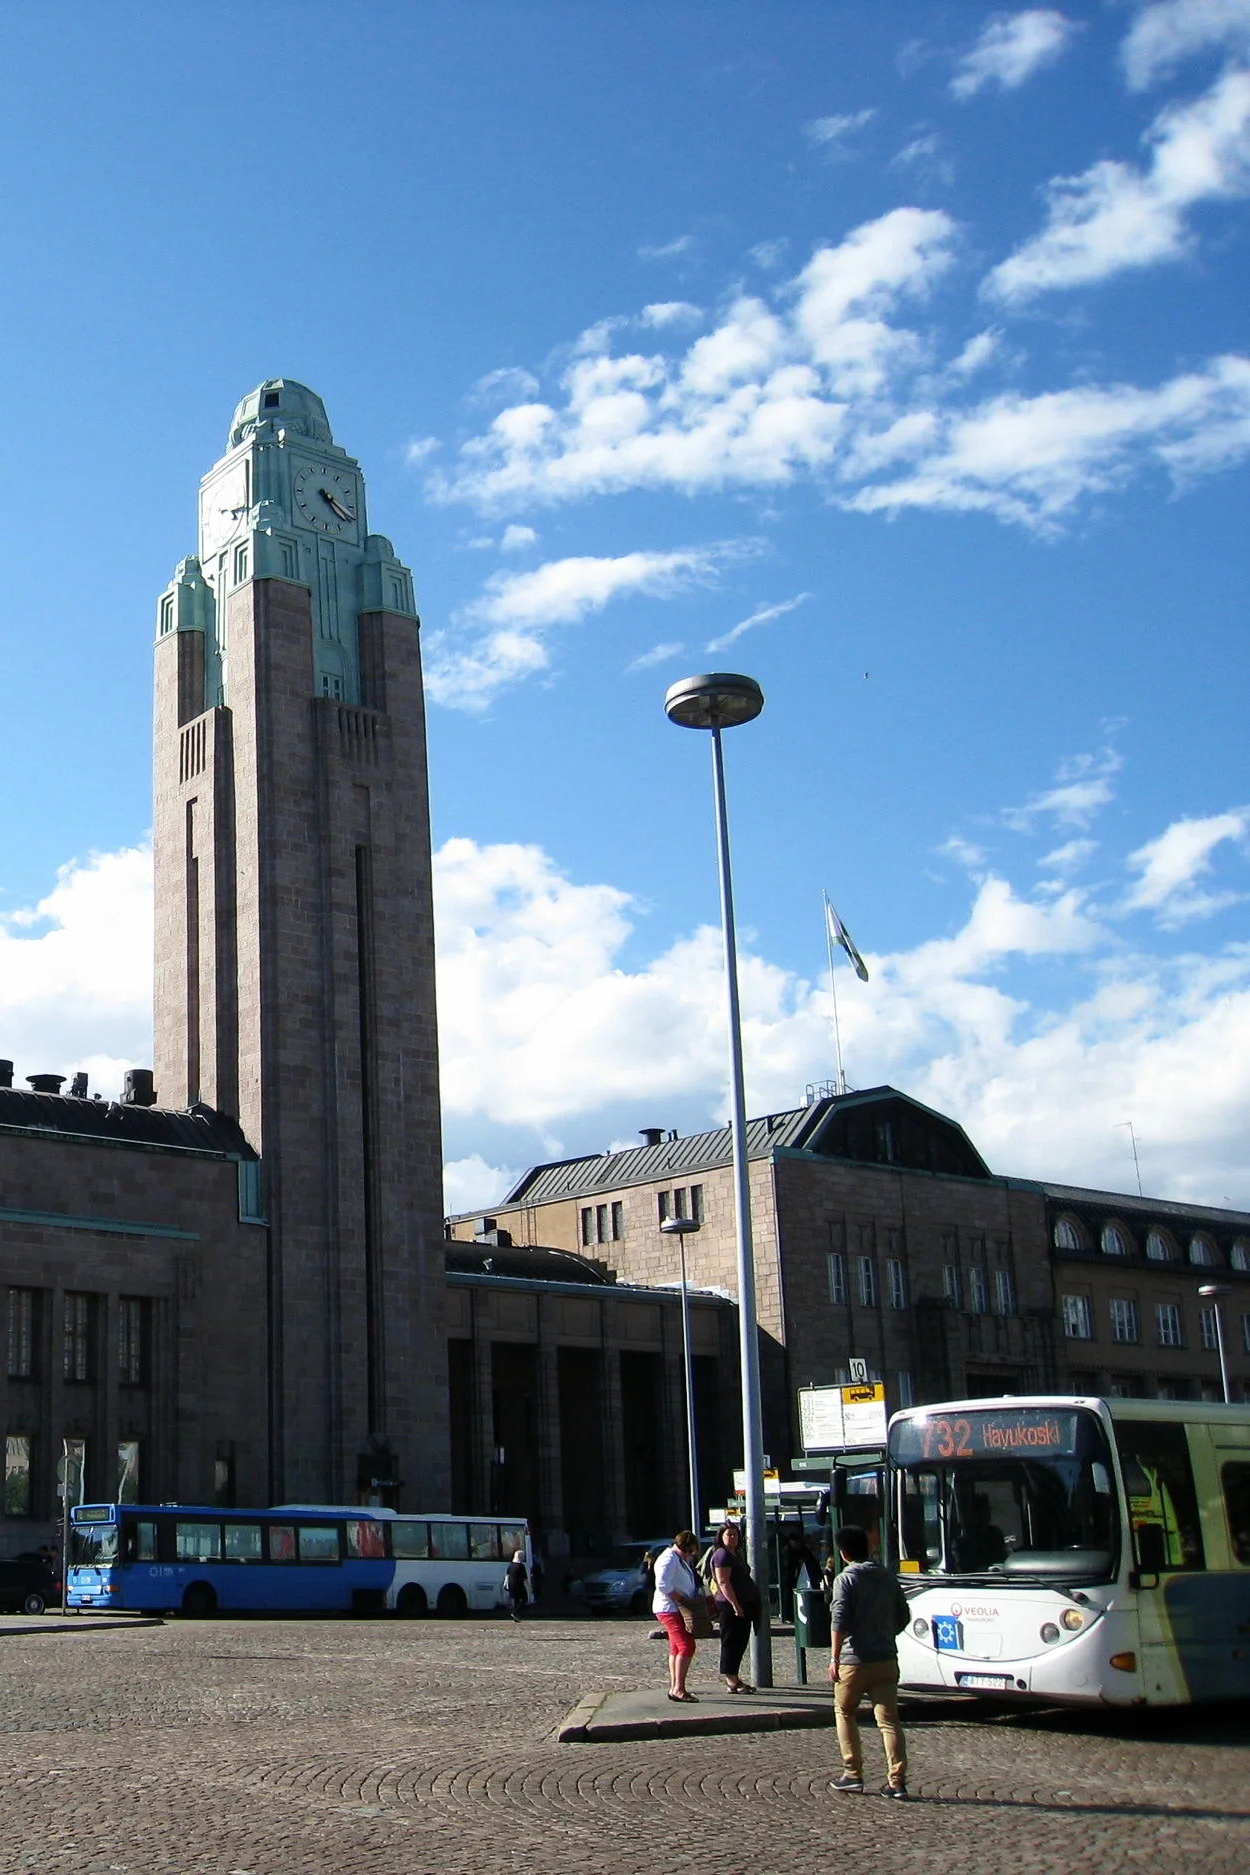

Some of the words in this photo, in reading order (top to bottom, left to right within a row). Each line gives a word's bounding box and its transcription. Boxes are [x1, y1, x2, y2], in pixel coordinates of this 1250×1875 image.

[852, 1362, 865, 1378] 10
[923, 1420, 973, 1457] 732
[982, 1420, 1060, 1448] Havukoski
[964, 1607, 999, 1616] VEOLIA
